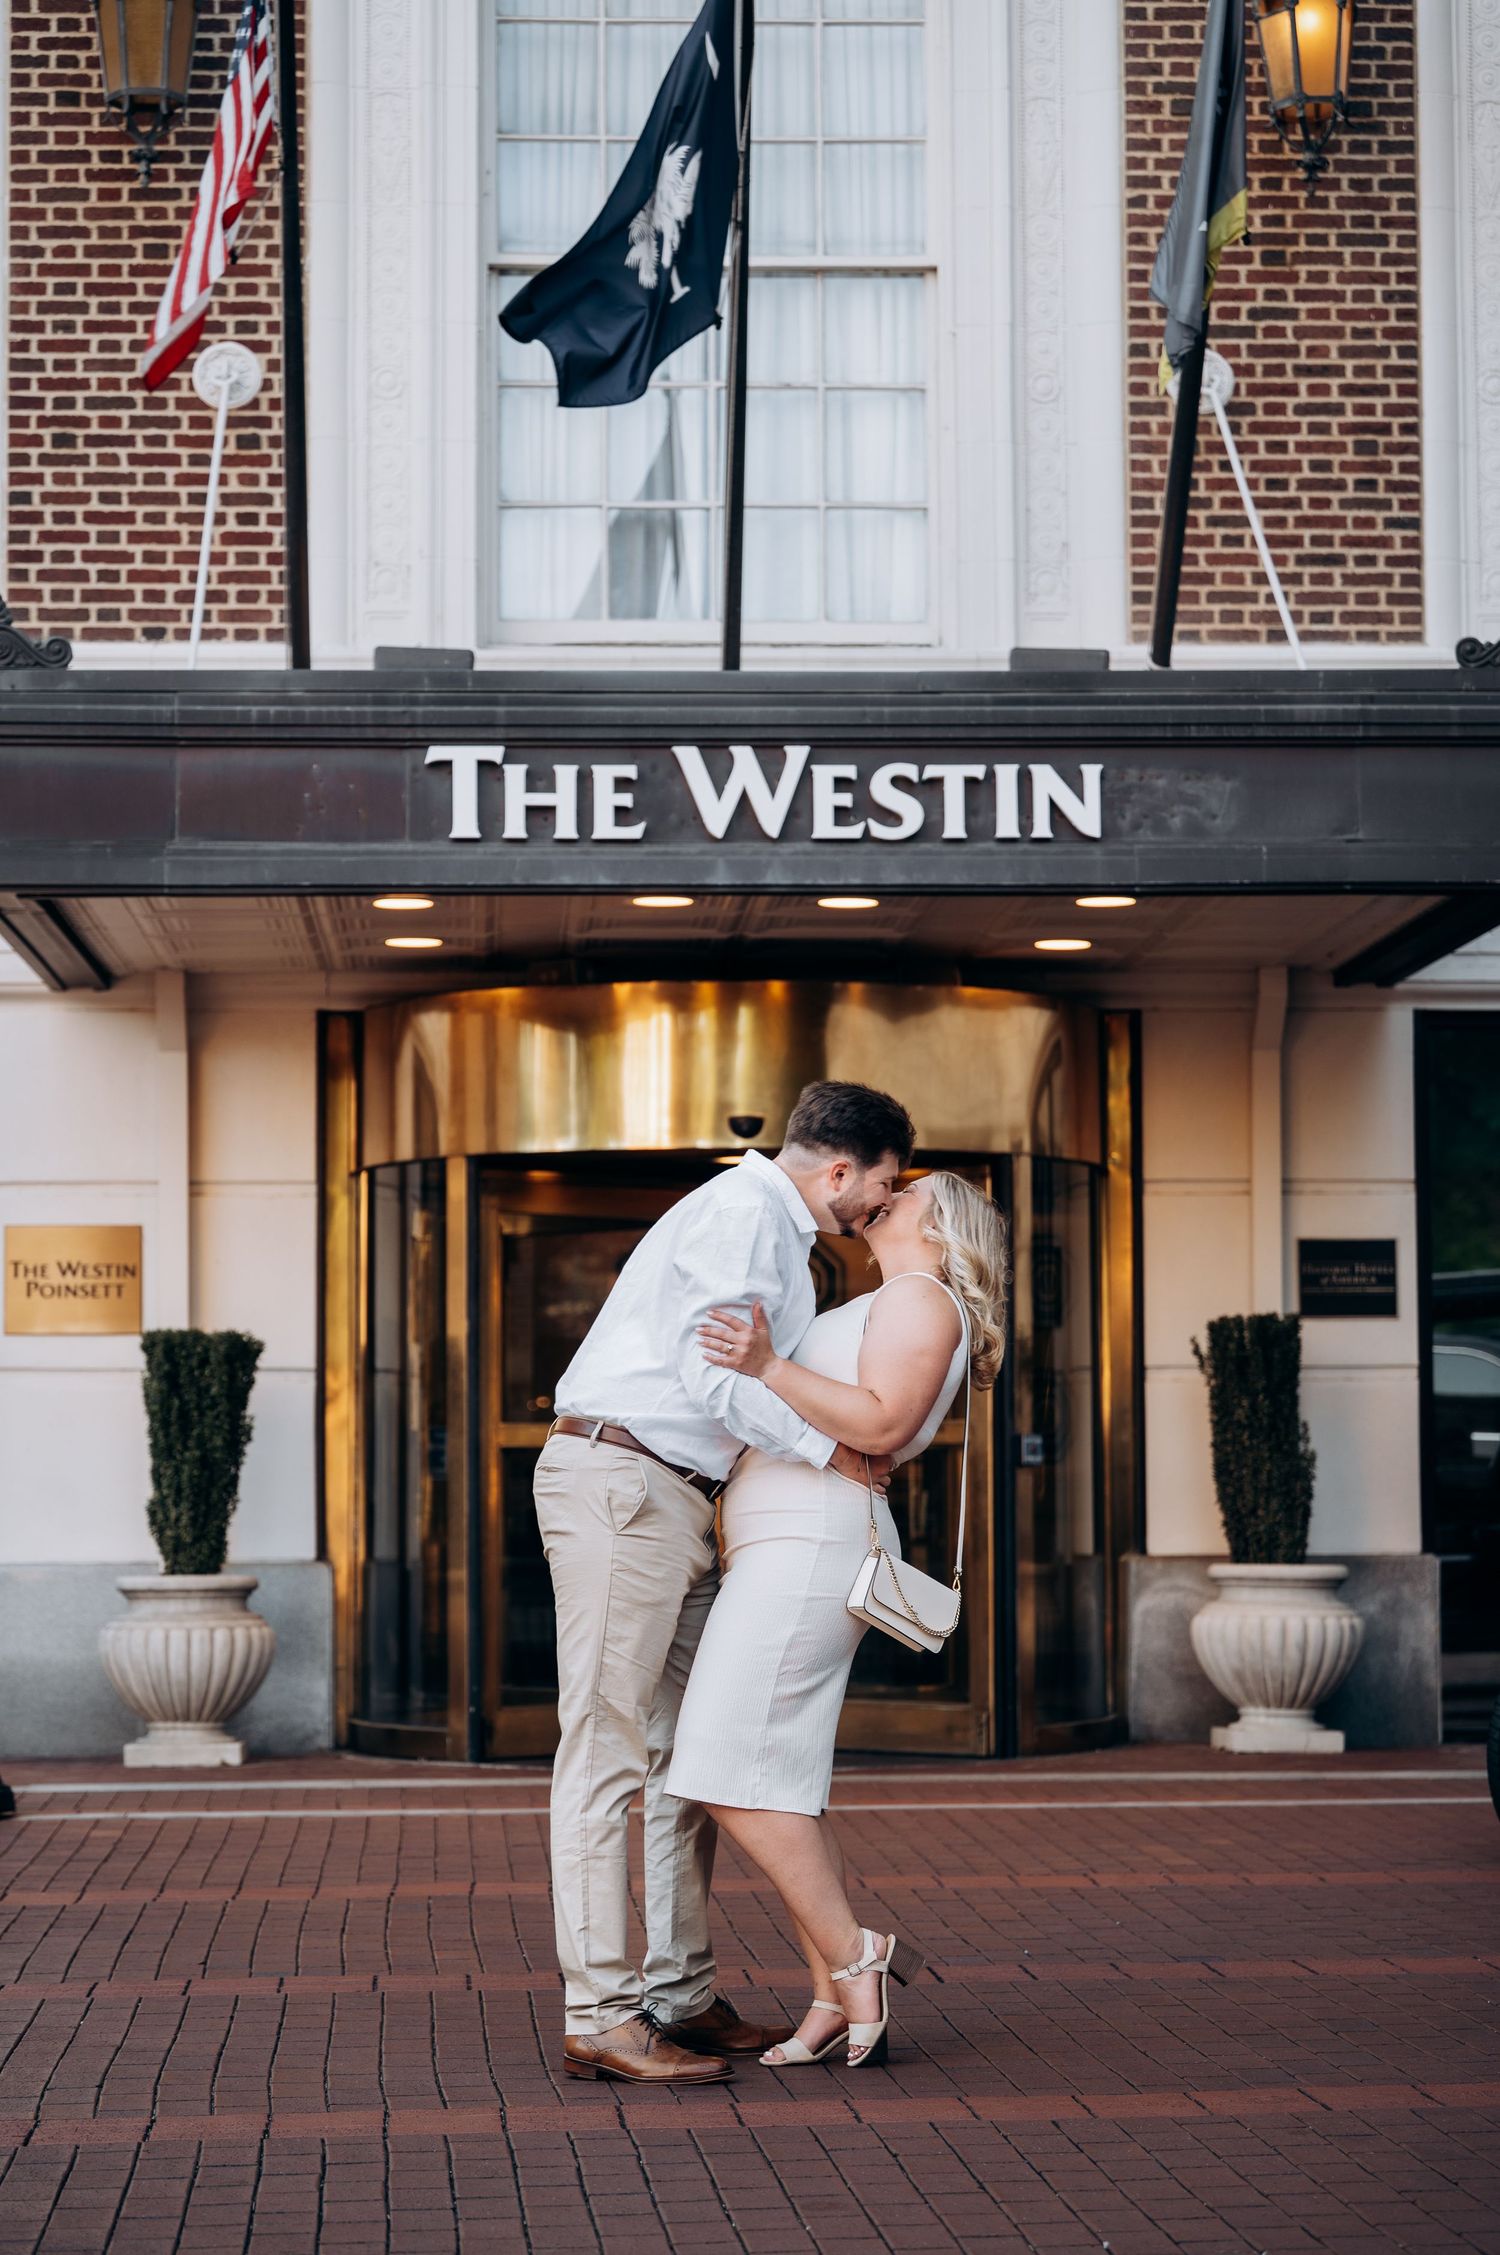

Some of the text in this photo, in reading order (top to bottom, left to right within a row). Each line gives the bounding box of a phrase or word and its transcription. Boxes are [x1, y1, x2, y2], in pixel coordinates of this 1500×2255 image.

[424, 745, 1104, 841] THE WESTIN
[11, 1260, 137, 1278] THE WESTIN
[26, 1281, 125, 1299] POINSETT
